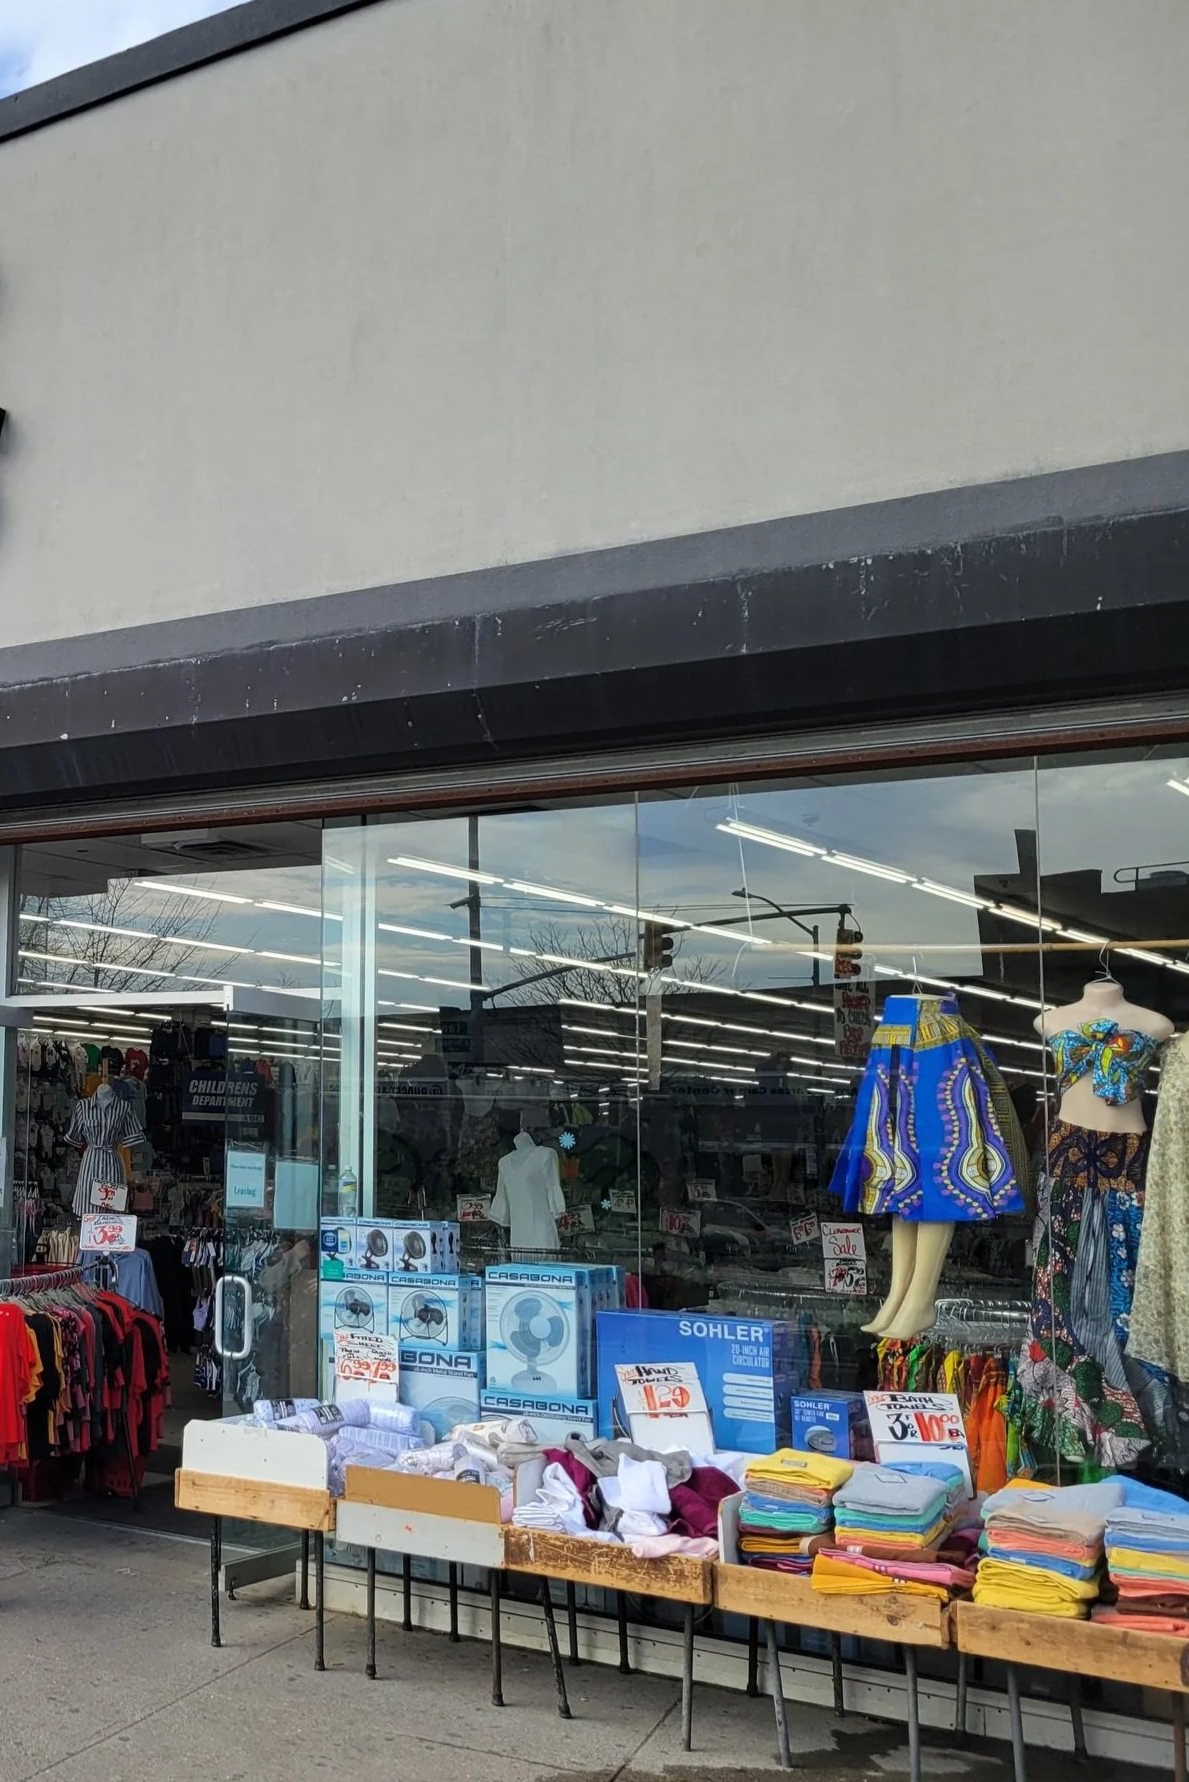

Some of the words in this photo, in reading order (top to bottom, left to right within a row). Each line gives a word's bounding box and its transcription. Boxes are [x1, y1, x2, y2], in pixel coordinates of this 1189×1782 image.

[188, 1080, 258, 1095] CHILDRENS
[191, 1095, 254, 1107] DEPARTMENT
[829, 1234, 863, 1257] Sale
[343, 1271, 385, 1281] ABONA
[390, 1276, 457, 1286] CASABONA
[487, 1271, 574, 1284] CASABONA
[678, 1320, 765, 1343] SOHLER
[400, 1349, 472, 1370] BONA
[794, 1400, 830, 1410] SOHLER
[888, 1393, 934, 1404] BATH
[483, 1395, 589, 1416] CASABONA
